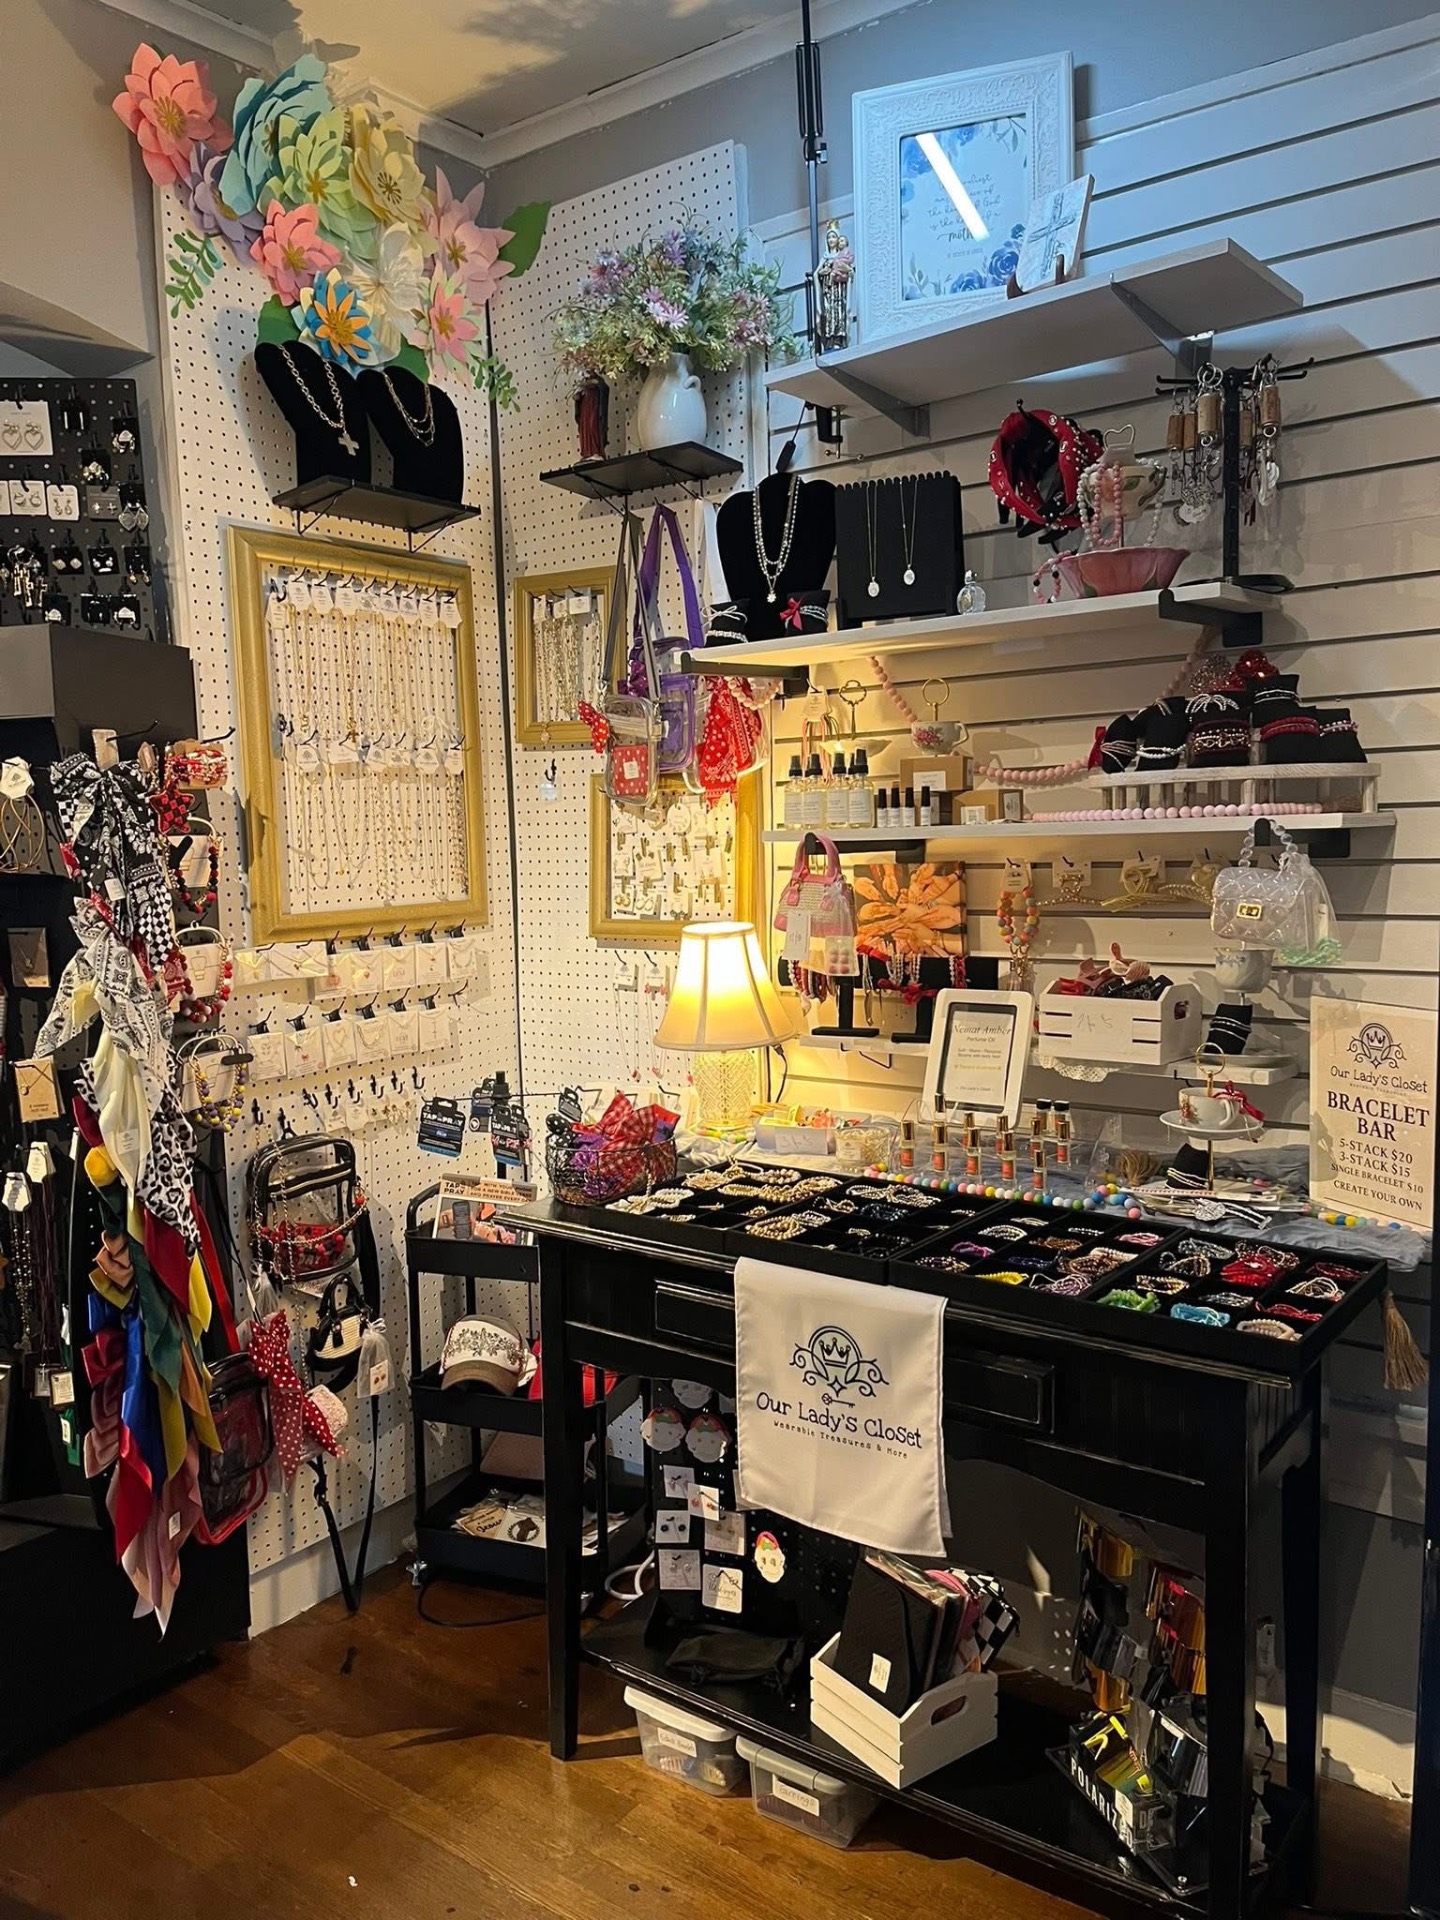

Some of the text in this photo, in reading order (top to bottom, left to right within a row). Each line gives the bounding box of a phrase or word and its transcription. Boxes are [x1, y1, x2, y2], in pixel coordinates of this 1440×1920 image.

[982, 1025, 1012, 1035] Amber
[1330, 1065, 1350, 1079] Our
[1353, 1069, 1388, 1086] Lady's
[422, 1112, 437, 1121] TAP
[1327, 1091, 1430, 1127] BRACELET
[1357, 1117, 1397, 1141] BAR
[1339, 1138, 1413, 1164] 5-STACK $20
[1339, 1151, 1411, 1178] 3-STACK $15
[1331, 1163, 1424, 1194] SINGLE BRACELET $10
[1333, 1180, 1422, 1210] CREATE YOUR OWN
[756, 1392, 792, 1415] Our
[798, 1402, 858, 1433] Lady's
[773, 1420, 908, 1459] Wearable Treasures & More
[1070, 1756, 1133, 1849] POLARIZD
